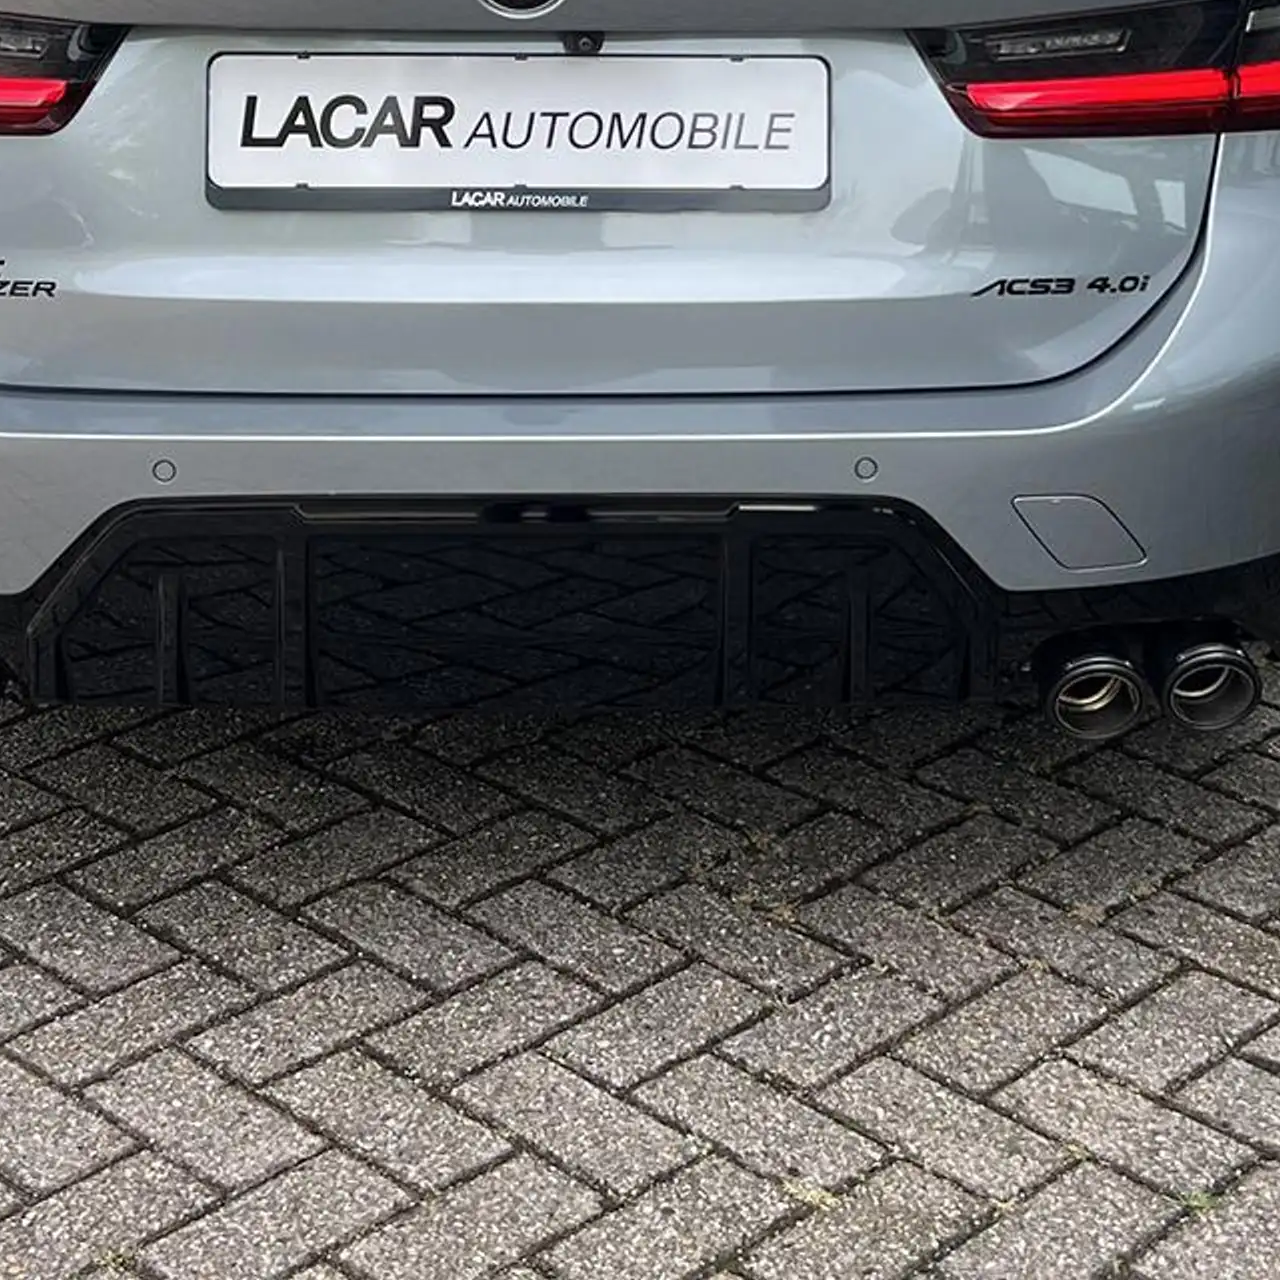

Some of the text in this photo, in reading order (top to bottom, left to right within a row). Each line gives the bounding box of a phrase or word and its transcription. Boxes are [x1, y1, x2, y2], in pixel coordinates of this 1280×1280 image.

[240, 94, 796, 150] LACAR AUTOMOBILE
[451, 191, 589, 207] LACAR AUTOMOBILE
[1086, 275, 1150, 294] 4.0i
